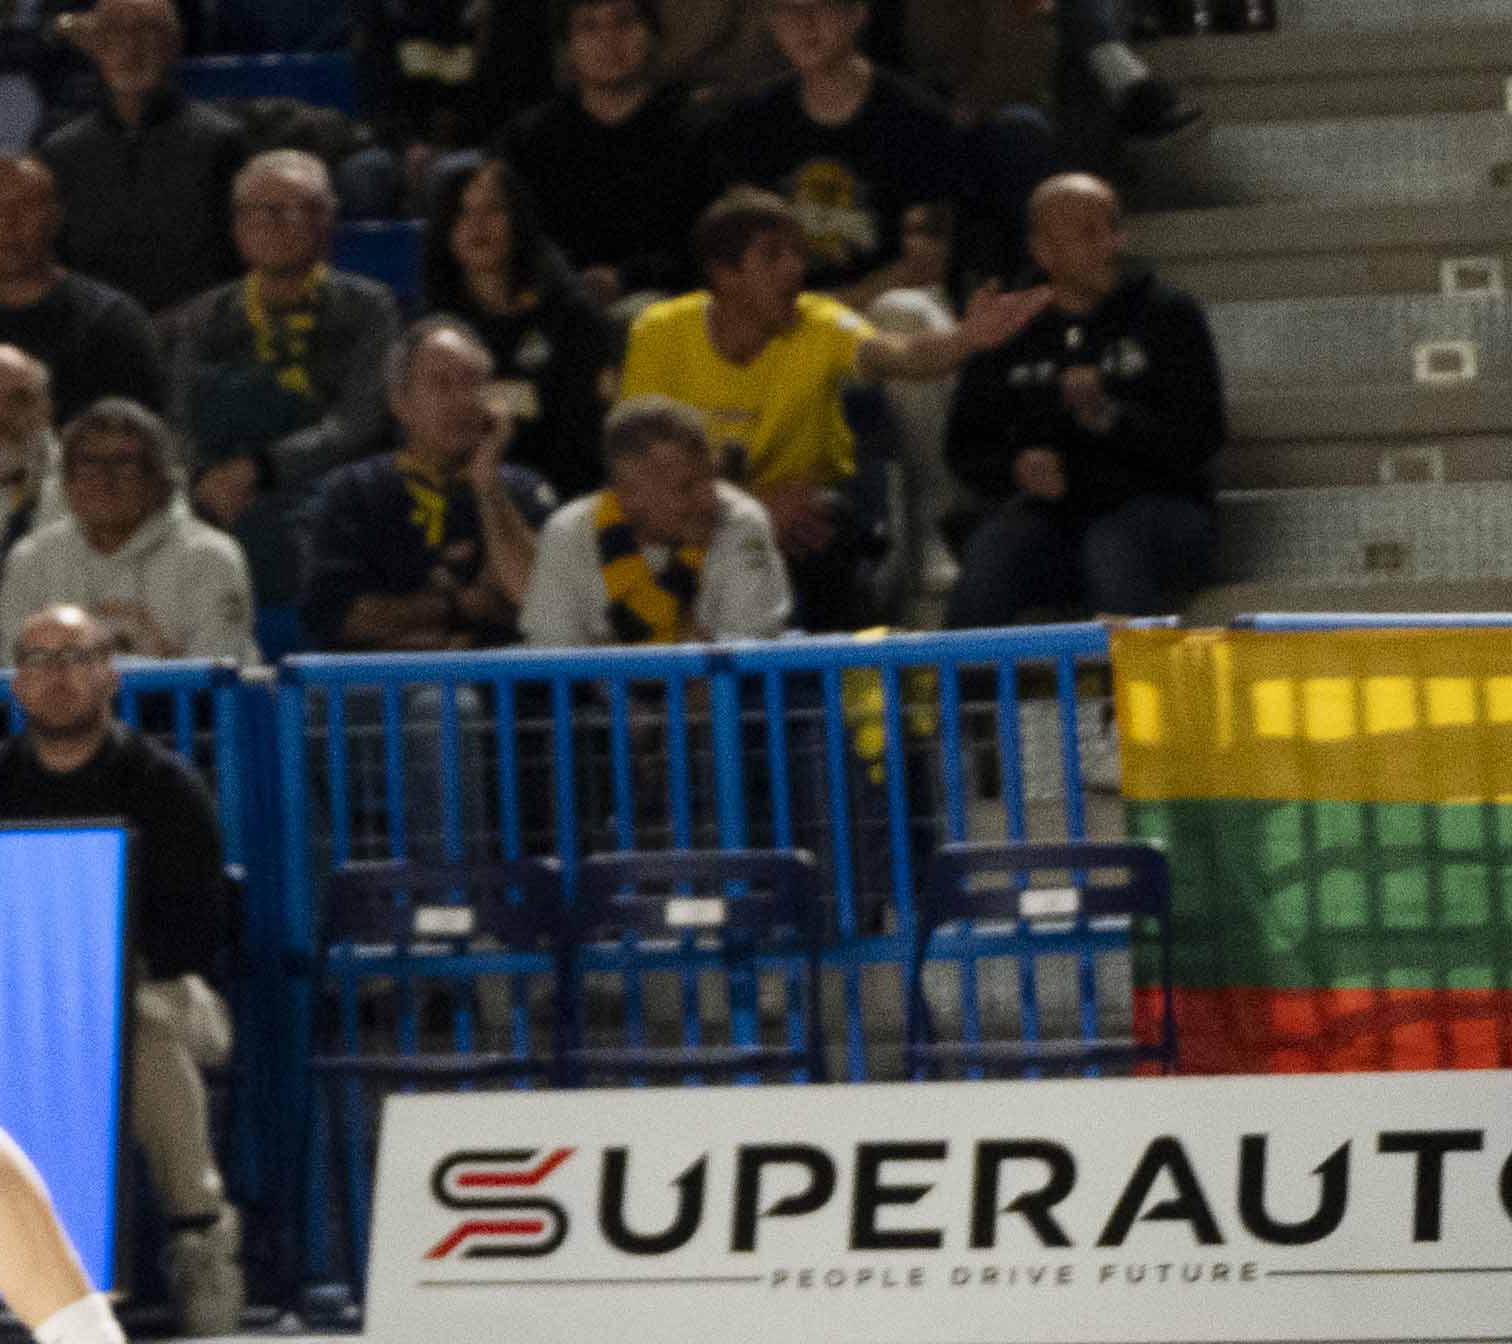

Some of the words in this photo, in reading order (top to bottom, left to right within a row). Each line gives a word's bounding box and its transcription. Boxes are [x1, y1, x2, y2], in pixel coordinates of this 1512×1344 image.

[424, 1128, 1512, 1260] SUPERAUT
[771, 1265, 928, 1290] PEOPLE
[950, 1264, 1076, 1287] DRIVE
[1096, 1261, 1261, 1286] FUTURE
